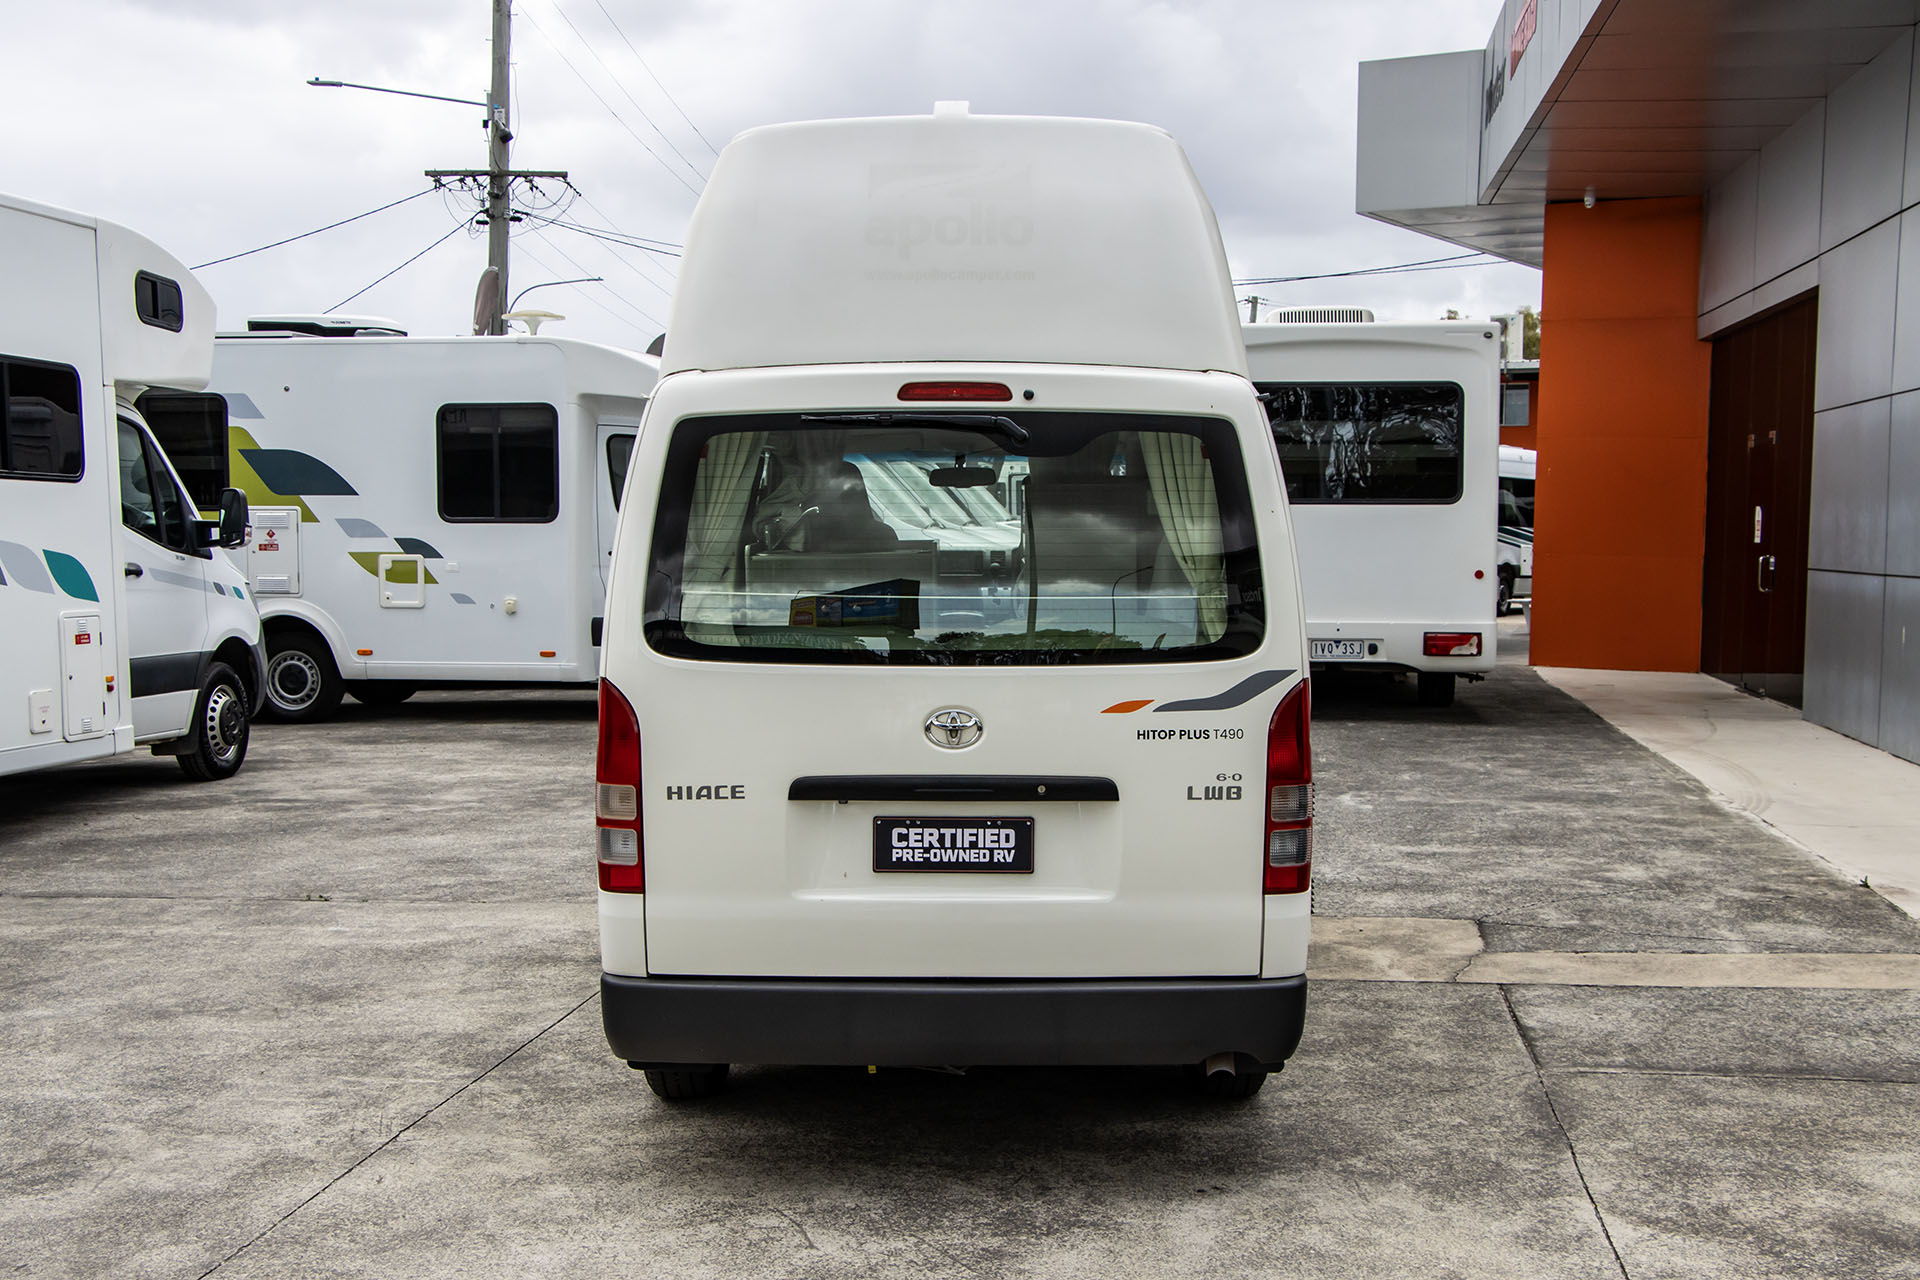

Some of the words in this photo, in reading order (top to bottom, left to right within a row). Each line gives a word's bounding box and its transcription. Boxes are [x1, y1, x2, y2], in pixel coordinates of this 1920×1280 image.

[863, 202, 1034, 260] apollo
[1137, 729, 1176, 740] HITOP
[1179, 729, 1210, 740] PLUS
[1213, 728, 1244, 739] T490
[666, 785, 745, 800] HIACE
[1187, 786, 1242, 800] LWB
[892, 828, 1016, 848] CERTIFIED
[892, 849, 990, 862] PRE-OWNED
[993, 850, 1015, 863] RV
